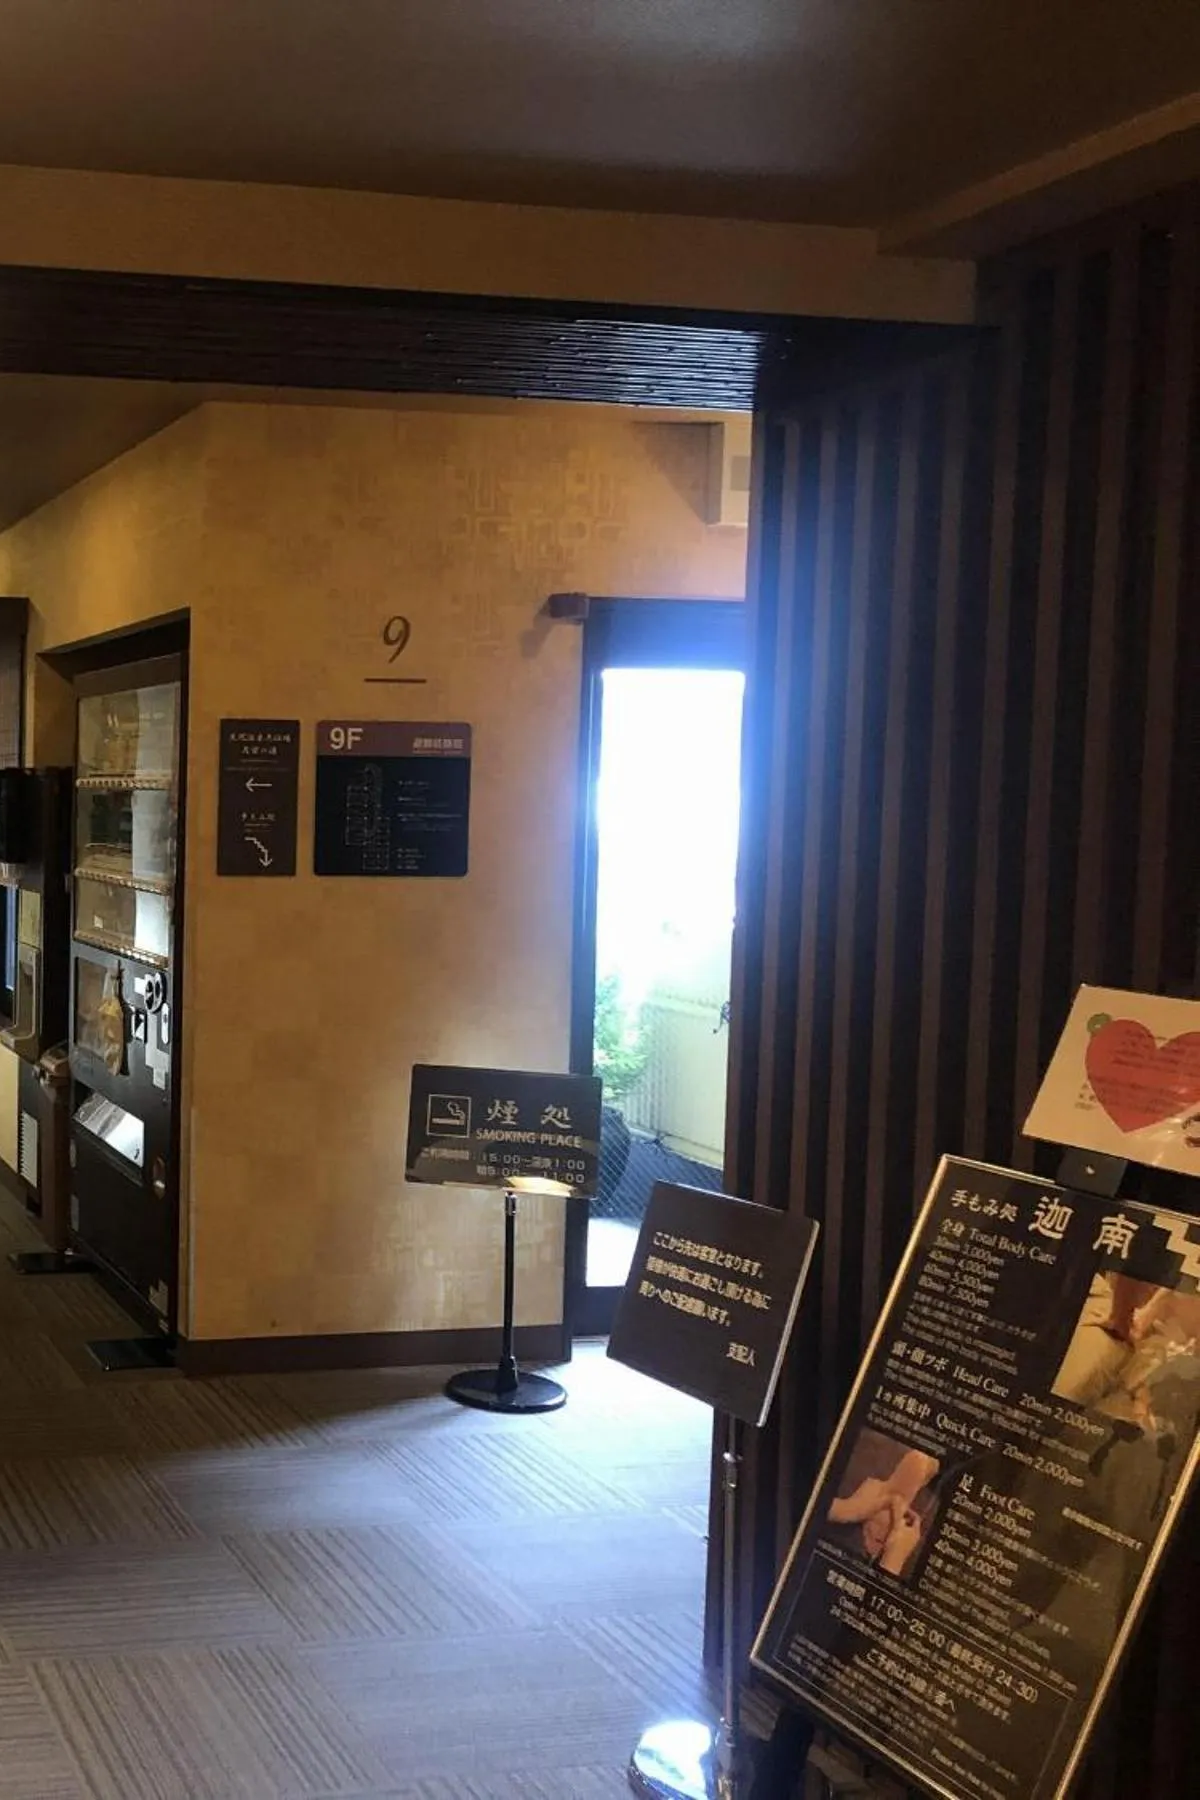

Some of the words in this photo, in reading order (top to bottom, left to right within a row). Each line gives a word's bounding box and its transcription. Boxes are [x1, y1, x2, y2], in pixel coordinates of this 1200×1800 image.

[382, 615, 411, 664] 9
[329, 727, 364, 750] 9F
[475, 1127, 537, 1145] SMOKING
[540, 1132, 583, 1149] PLACE
[969, 1227, 997, 1246] Total
[998, 1236, 1024, 1257] Body
[1028, 1246, 1056, 1264] Care
[952, 1365, 982, 1385] Head
[982, 1377, 1008, 1397] Care
[1019, 1392, 1051, 1415] 20min
[1054, 1407, 1104, 1435] 2,000yen
[936, 1412, 967, 1436] Quick
[969, 1427, 995, 1448] Care
[1002, 1442, 1033, 1465] 20min
[1034, 1456, 1083, 1486] 2,000yen
[952, 1491, 982, 1514] 20min
[984, 1507, 1031, 1537] 2,000yen
[958, 1473, 973, 1492] 足
[979, 1484, 1006, 1506] Foot
[1007, 1497, 1034, 1520] Care
[934, 1539, 964, 1561] 40min
[965, 1556, 1012, 1586] 4,000yen
[940, 1523, 970, 1546] 30min
[971, 1539, 1017, 1571] 3,000yen
